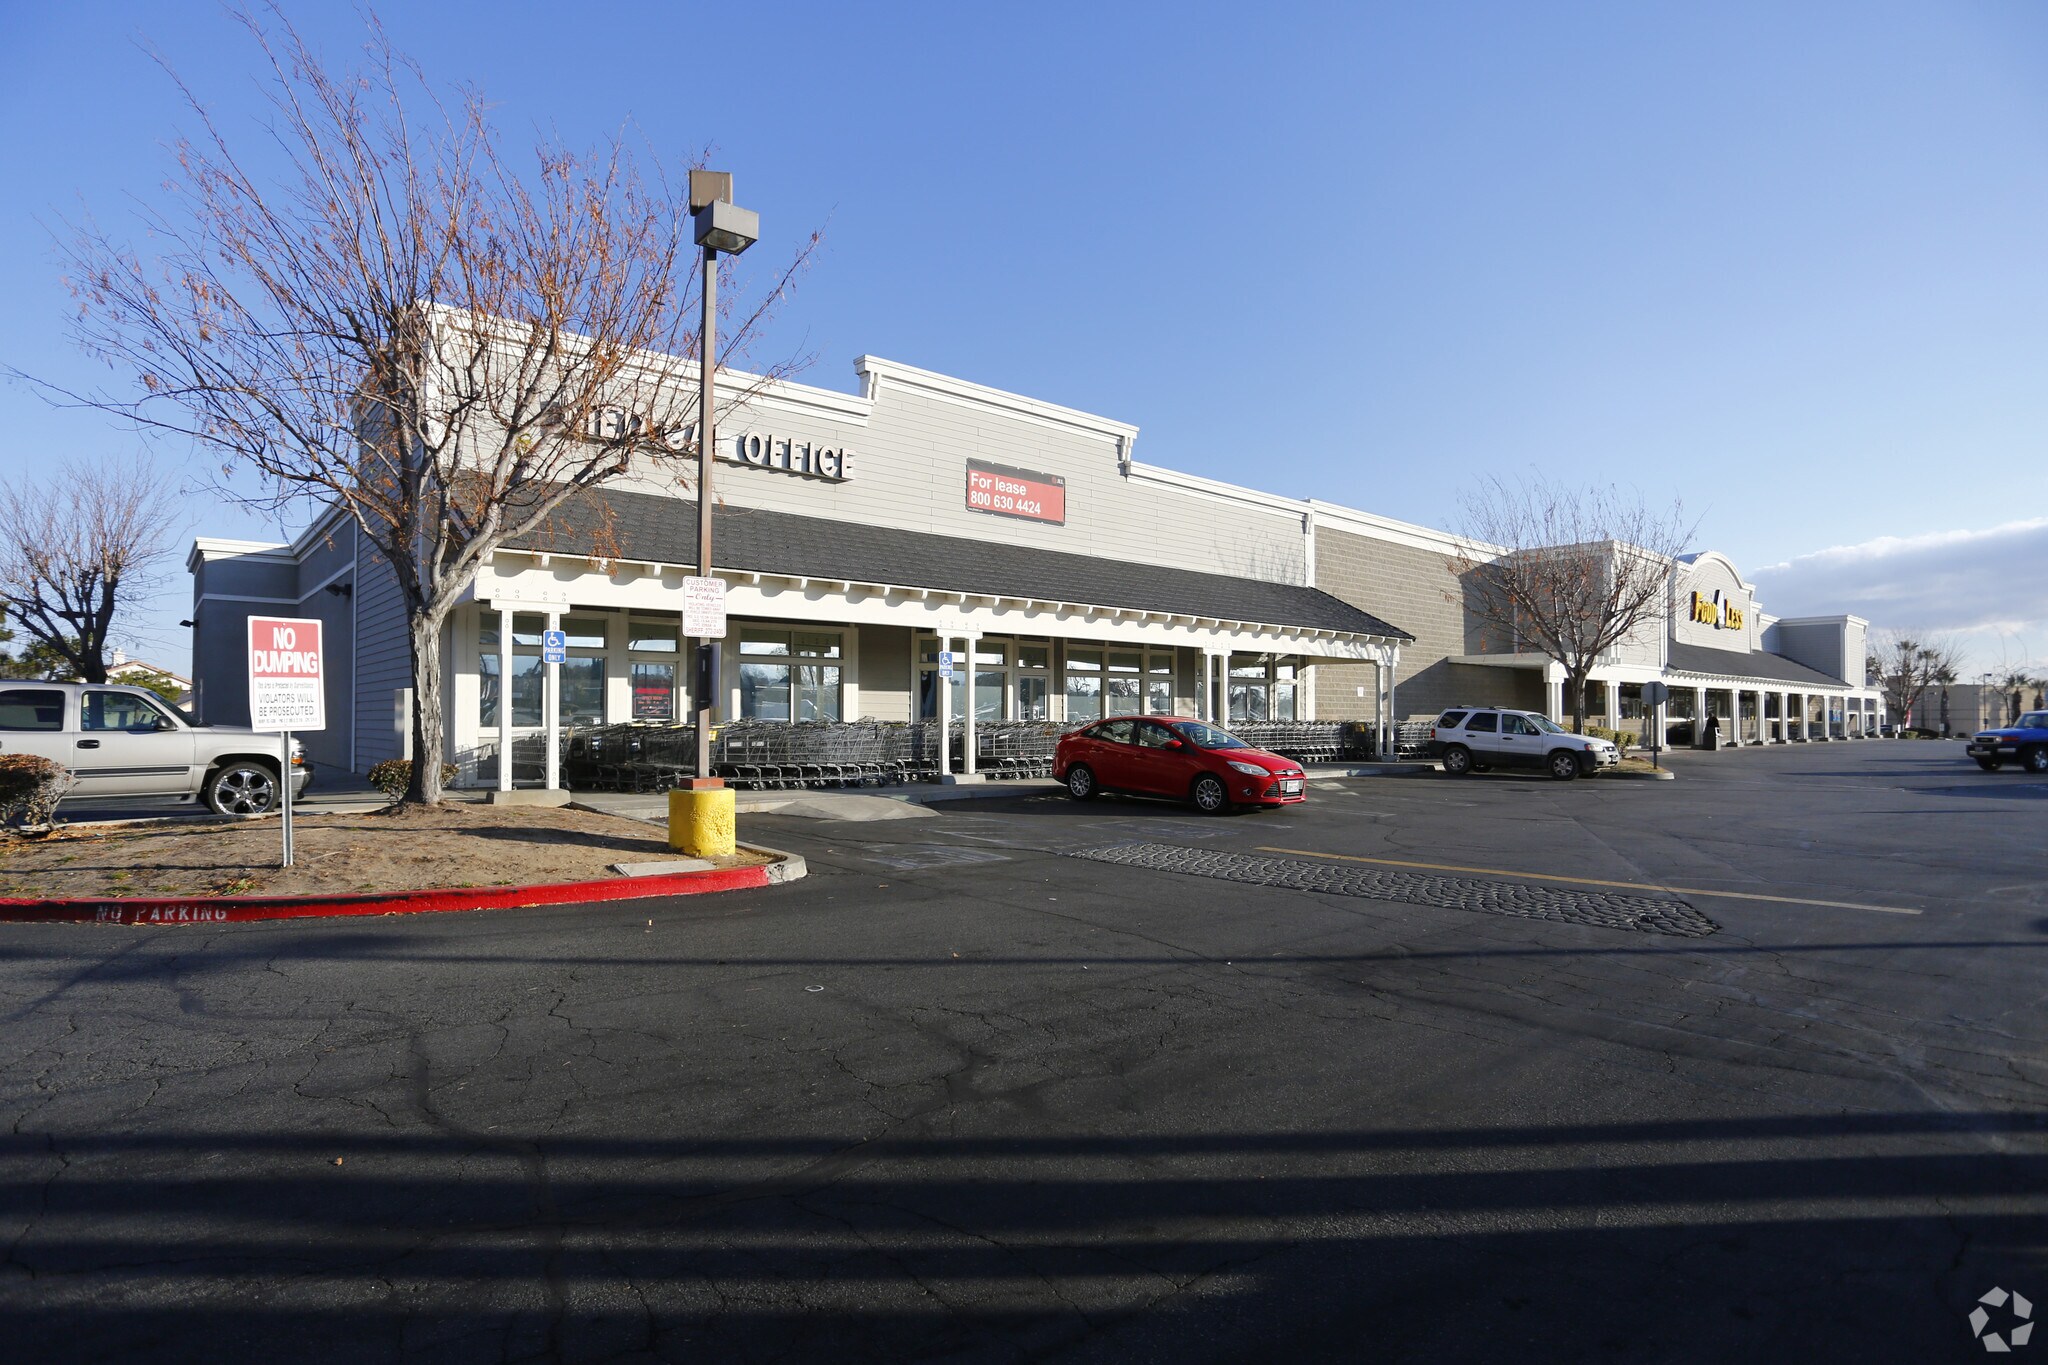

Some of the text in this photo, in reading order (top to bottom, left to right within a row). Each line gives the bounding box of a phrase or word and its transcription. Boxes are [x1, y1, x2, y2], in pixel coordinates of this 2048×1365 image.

[744, 431, 856, 480] OFFICE
[970, 472, 1027, 496] For lease
[970, 491, 1041, 515] 800 630 4424
[686, 579, 723, 587] CUSTOMER
[273, 627, 296, 650] NO
[253, 650, 318, 674] DUMPING
[259, 693, 314, 703] VIOLATORS WILL
[259, 705, 314, 716] BE PROSECUTED
[96, 904, 227, 921] NO PARKING
